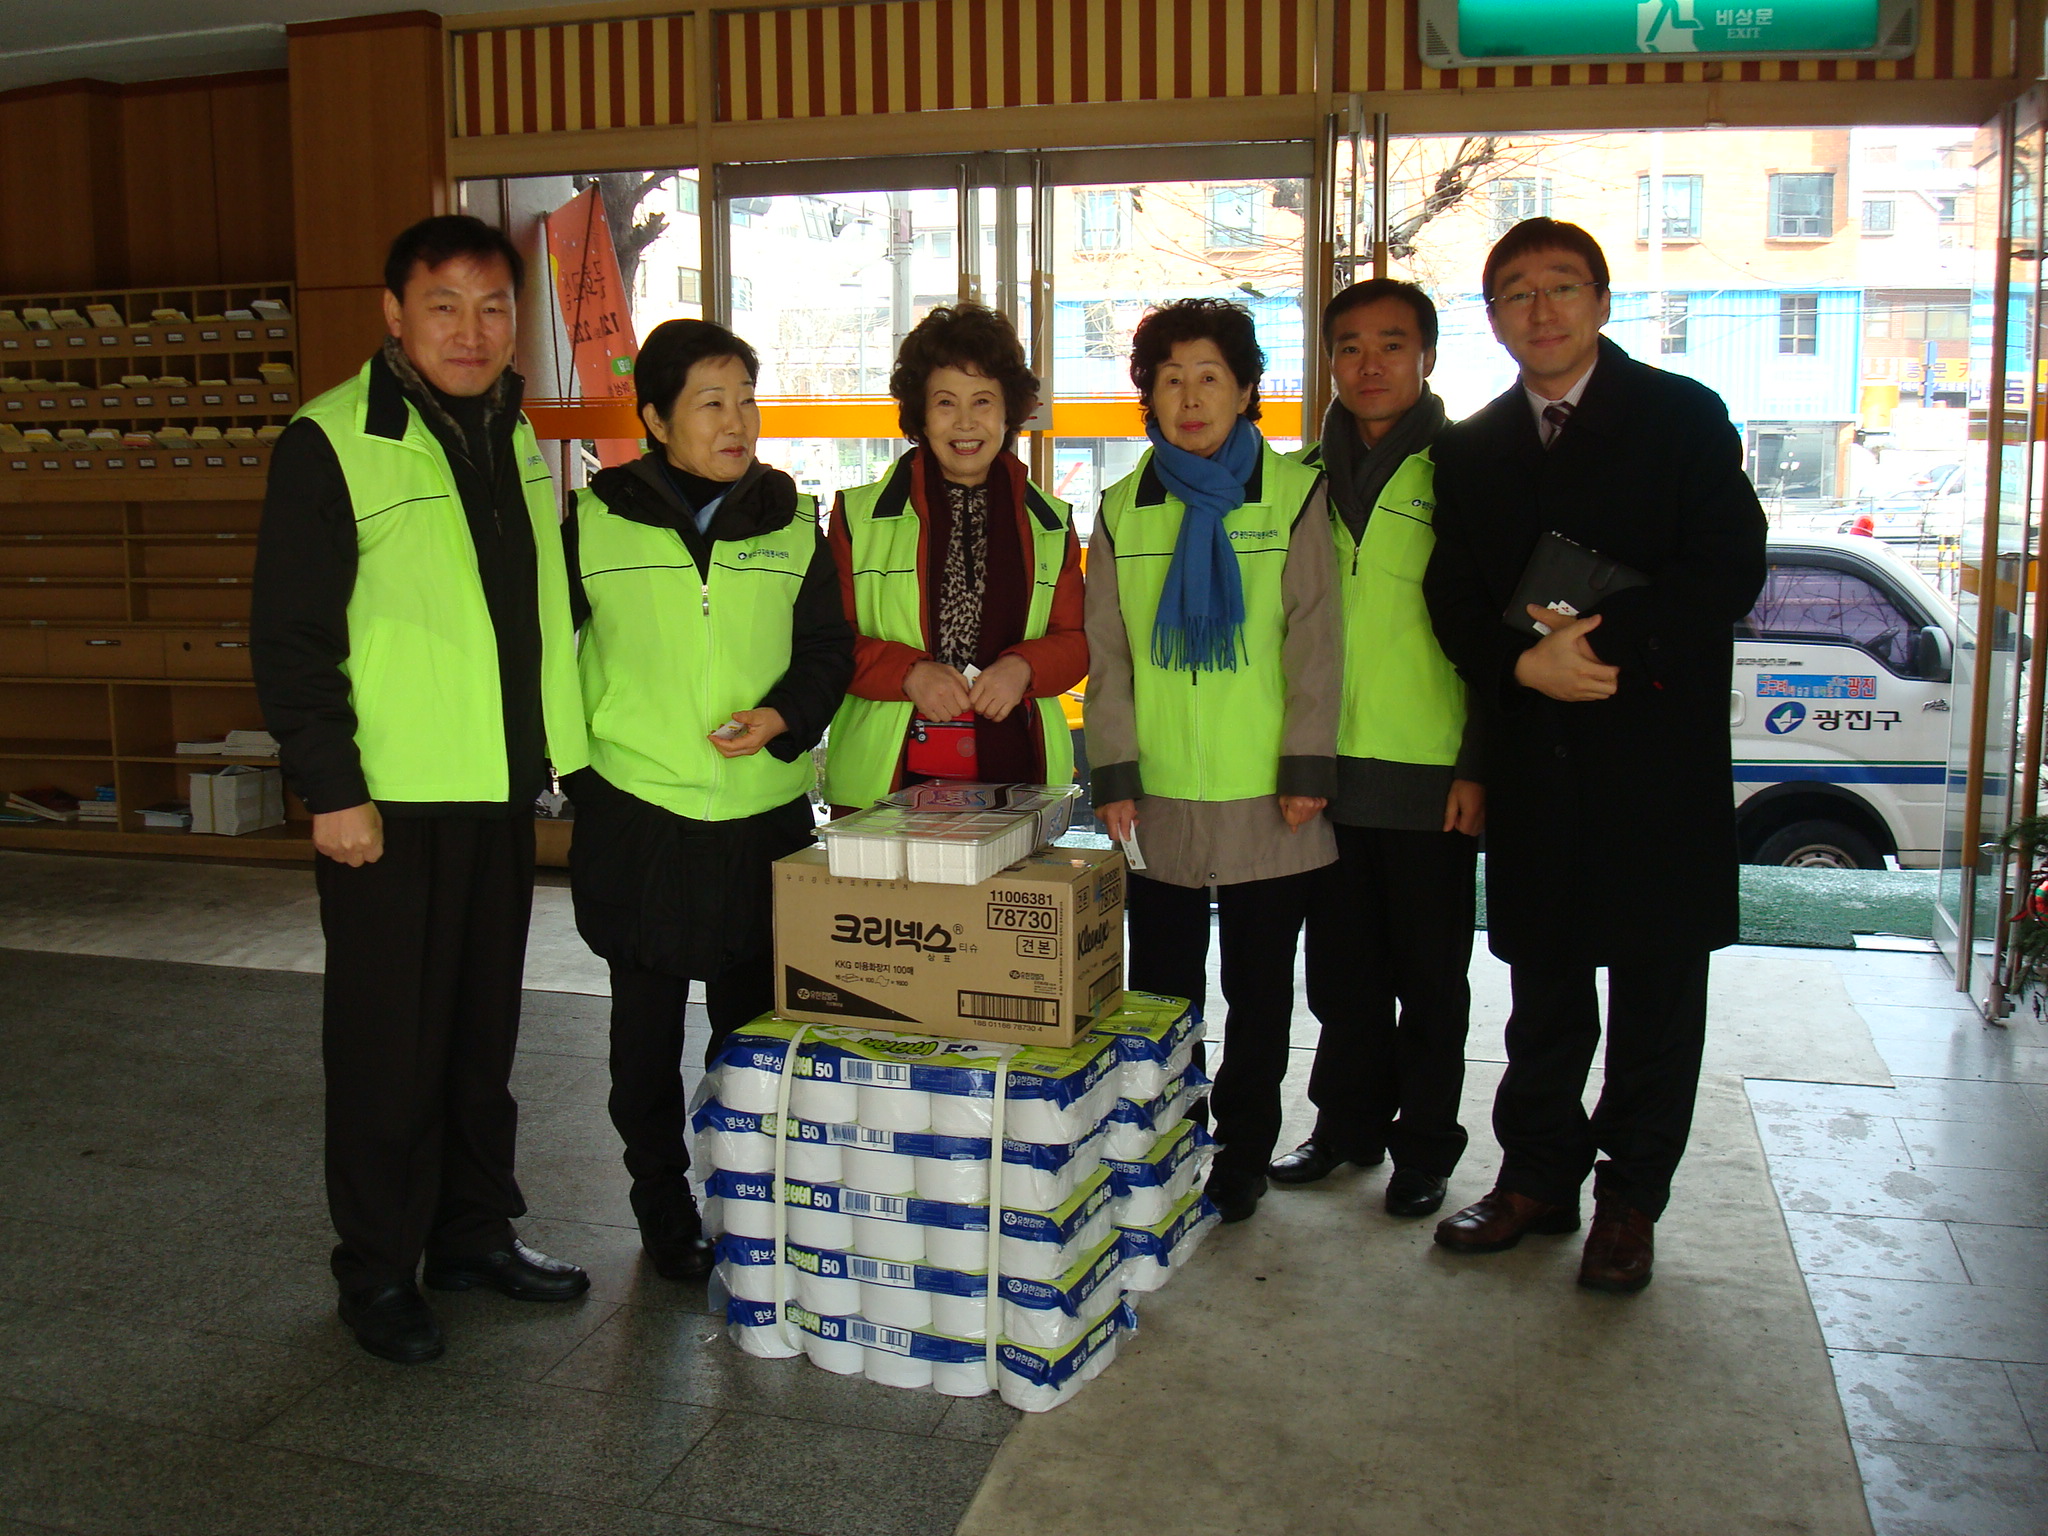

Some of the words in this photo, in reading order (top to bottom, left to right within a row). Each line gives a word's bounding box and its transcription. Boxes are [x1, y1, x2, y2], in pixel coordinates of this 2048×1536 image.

[1716, 8, 1774, 26] 비상문
[1727, 27, 1761, 39] EXIT
[1847, 677, 1875, 698] 광진
[1812, 709, 1902, 731] 광진구
[990, 890, 1053, 905] 11006381
[992, 908, 1052, 930] 78730
[958, 943, 978, 954] 티슈
[1022, 939, 1051, 955] 견본
[927, 954, 951, 963] 상표
[835, 960, 852, 970] KKG
[854, 962, 890, 974] 미용화장지
[893, 966, 914, 975] 100매
[810, 991, 839, 1002] 유한킴벌리
[1013, 1023, 1036, 1032] 78730
[815, 1062, 834, 1078] 50
[725, 1117, 756, 1130] 엠보싱
[802, 1125, 820, 1140] 50
[735, 1183, 767, 1199] 엠보싱
[813, 1192, 832, 1209] 50
[1017, 1215, 1047, 1229] 유한킴벌리
[821, 1258, 840, 1275] 50
[1022, 1283, 1052, 1298] 유한킴벌리
[754, 1309, 776, 1324] 엠보
[821, 1321, 839, 1338] 50
[1106, 1319, 1114, 1336] 50
[1015, 1352, 1045, 1372] 유한킴벌리
